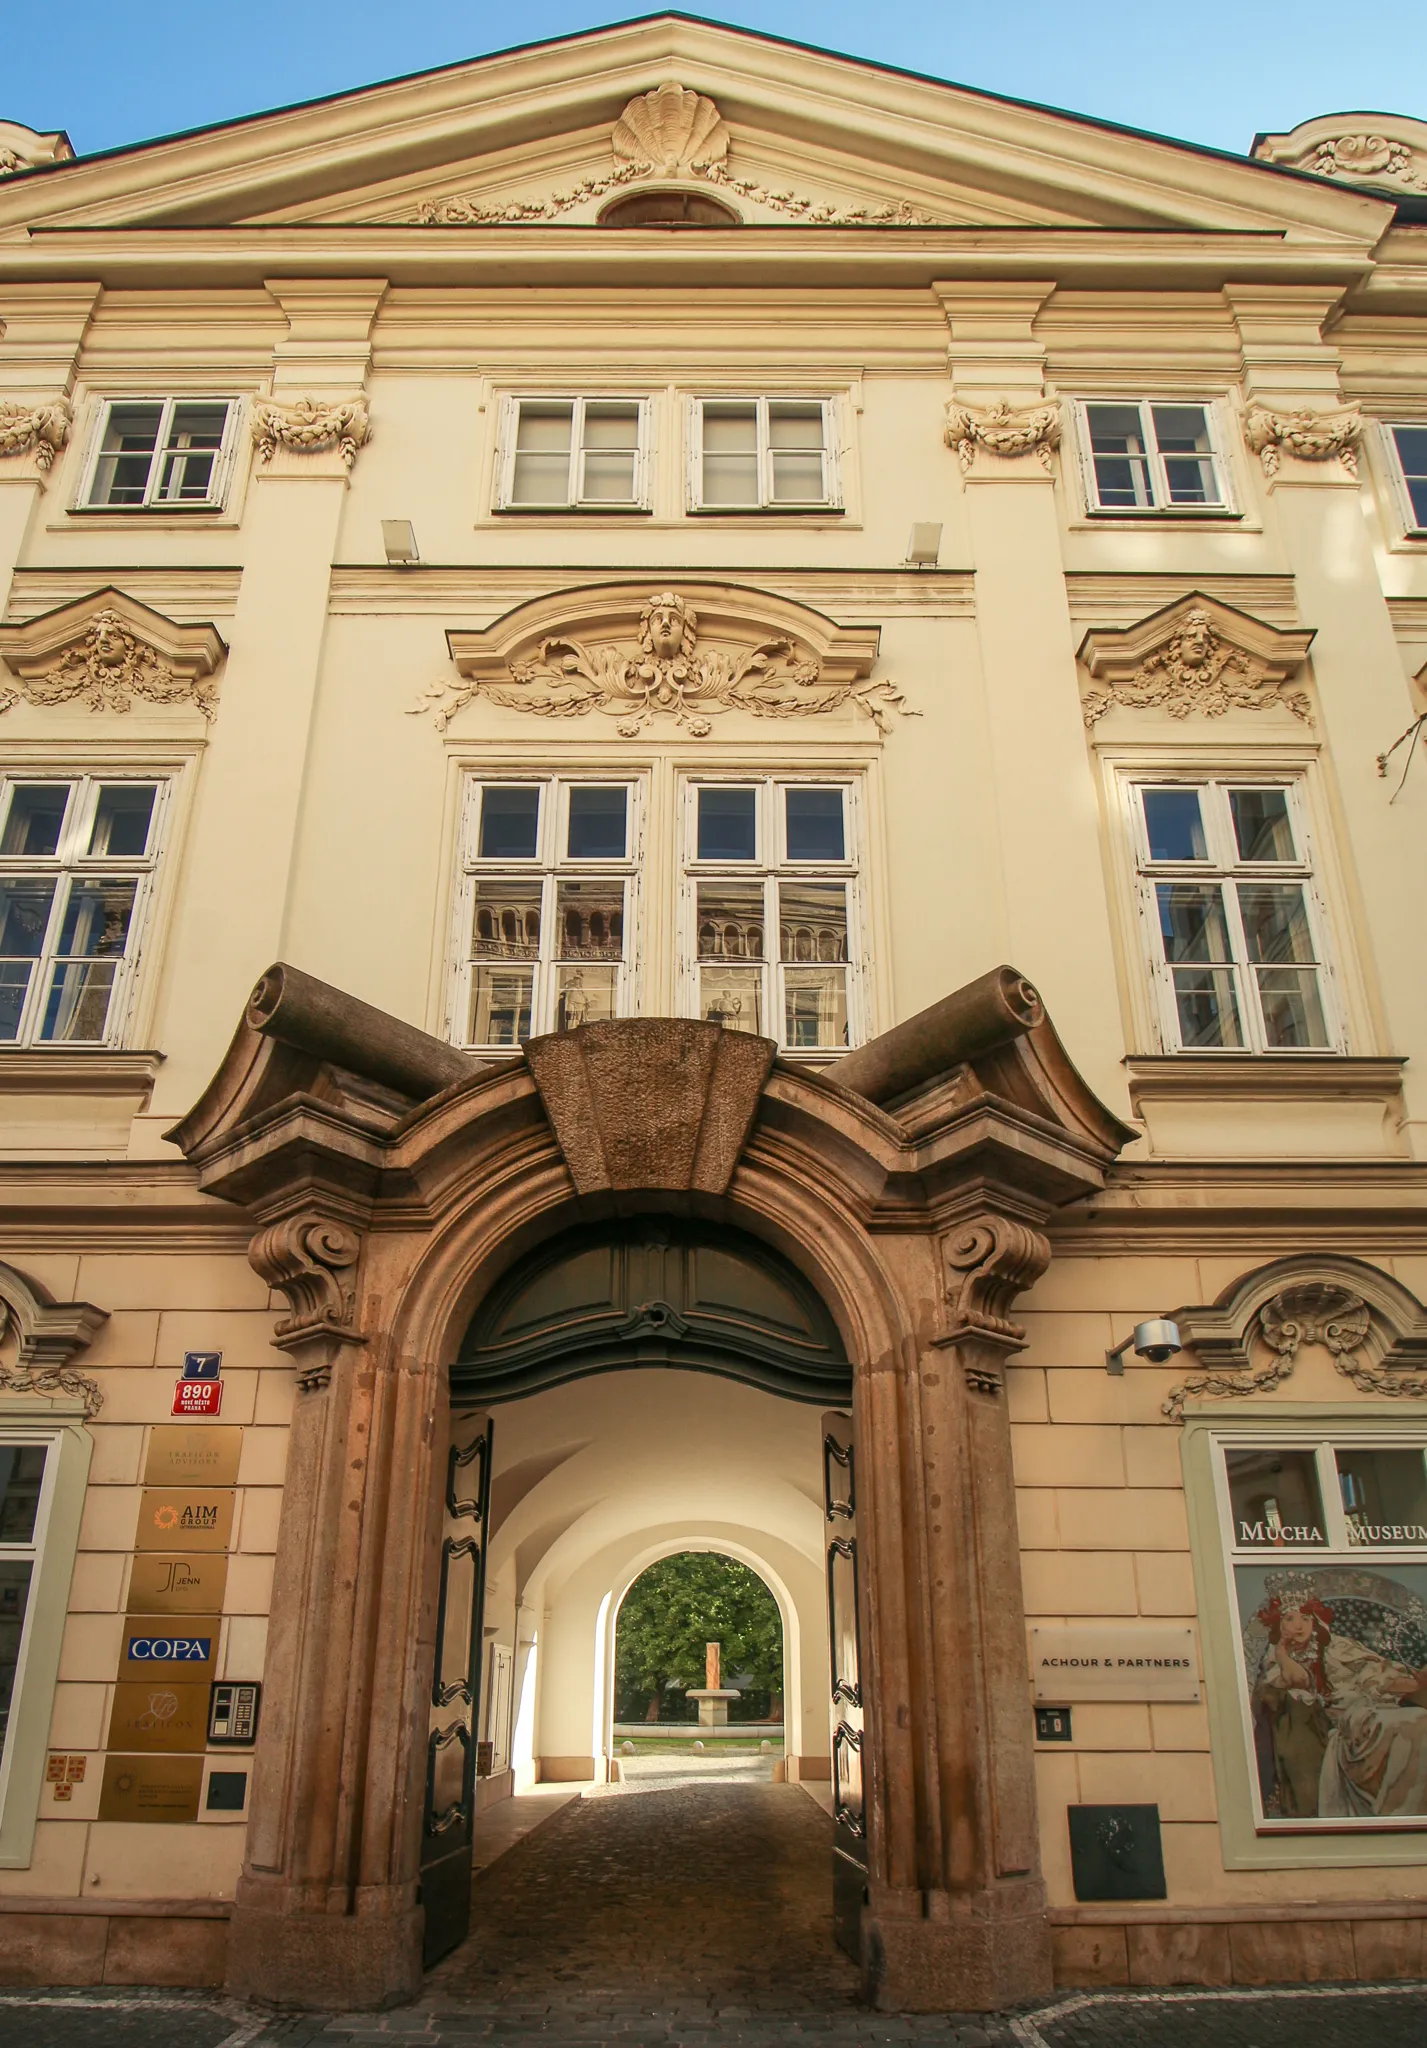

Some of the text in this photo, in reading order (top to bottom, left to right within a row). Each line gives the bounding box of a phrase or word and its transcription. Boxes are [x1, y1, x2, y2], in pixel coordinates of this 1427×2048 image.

[196, 1357, 206, 1373] 7
[182, 1384, 212, 1399] 890
[181, 1505, 218, 1519] AIM
[176, 1577, 201, 1585] JENN
[132, 1639, 206, 1659] COPA
[1041, 1658, 1190, 1667] ACHOUR & PARTNERS
